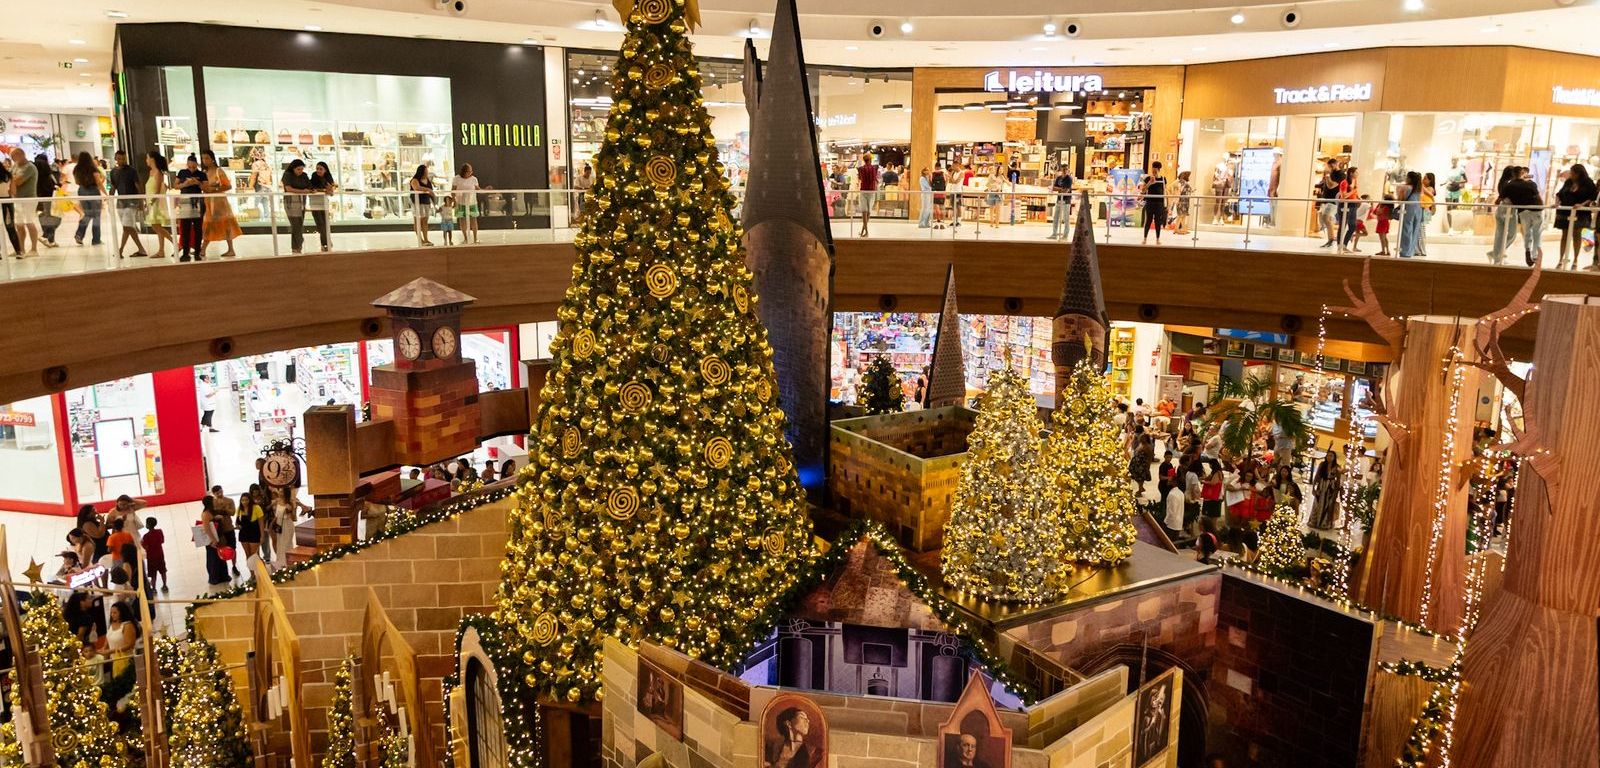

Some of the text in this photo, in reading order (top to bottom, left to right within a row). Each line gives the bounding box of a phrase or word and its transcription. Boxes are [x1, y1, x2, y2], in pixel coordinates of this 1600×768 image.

[1008, 71, 1103, 92] leitura
[461, 122, 541, 147] SANTA LOLLA
